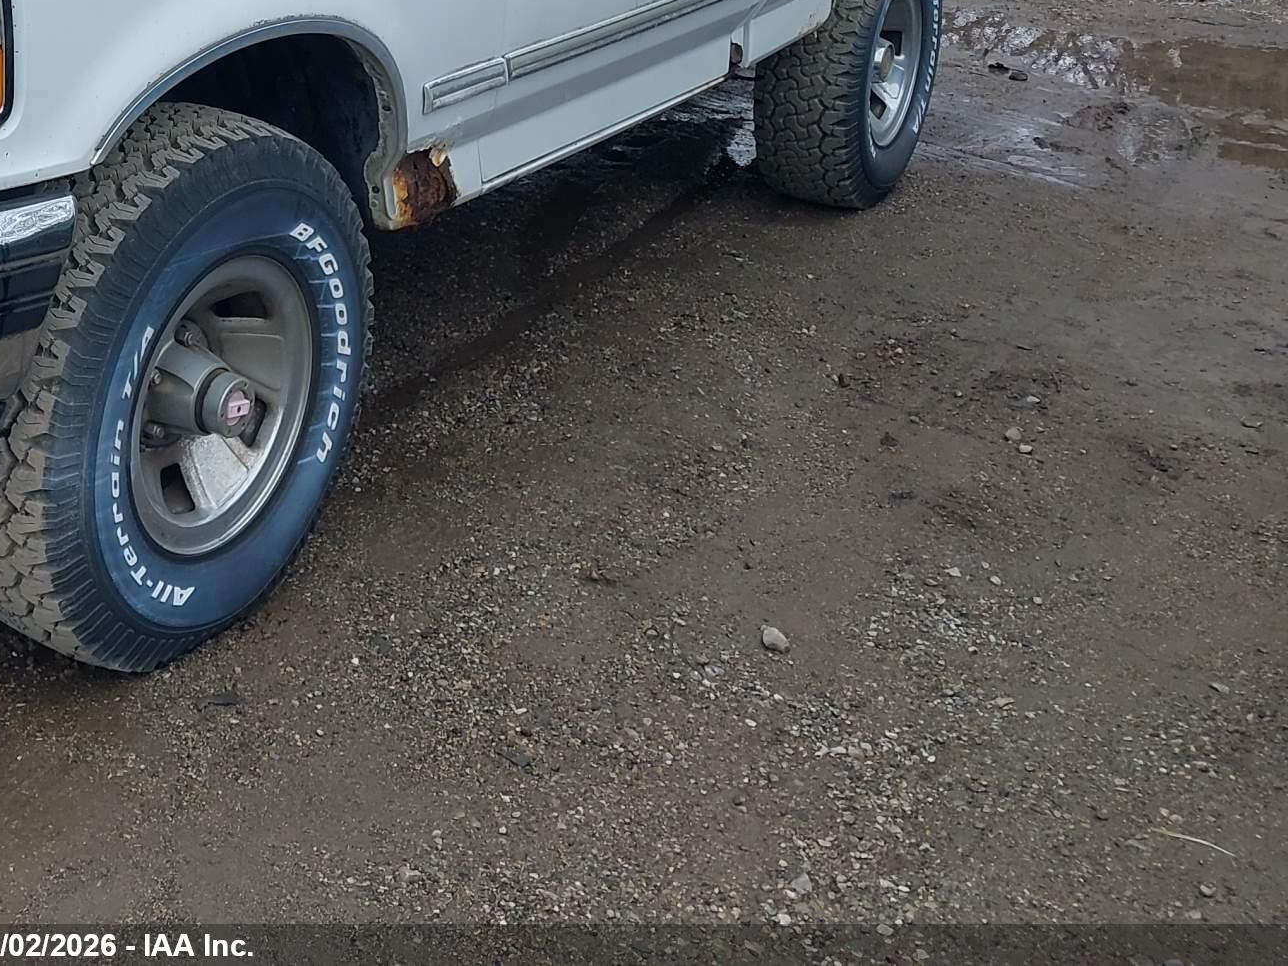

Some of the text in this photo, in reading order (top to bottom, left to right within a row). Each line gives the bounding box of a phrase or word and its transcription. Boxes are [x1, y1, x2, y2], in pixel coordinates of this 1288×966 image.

[912, 99, 927, 134] T/A
[289, 222, 352, 463] BFGoodrich
[112, 326, 195, 606] All-Terrain T/A
